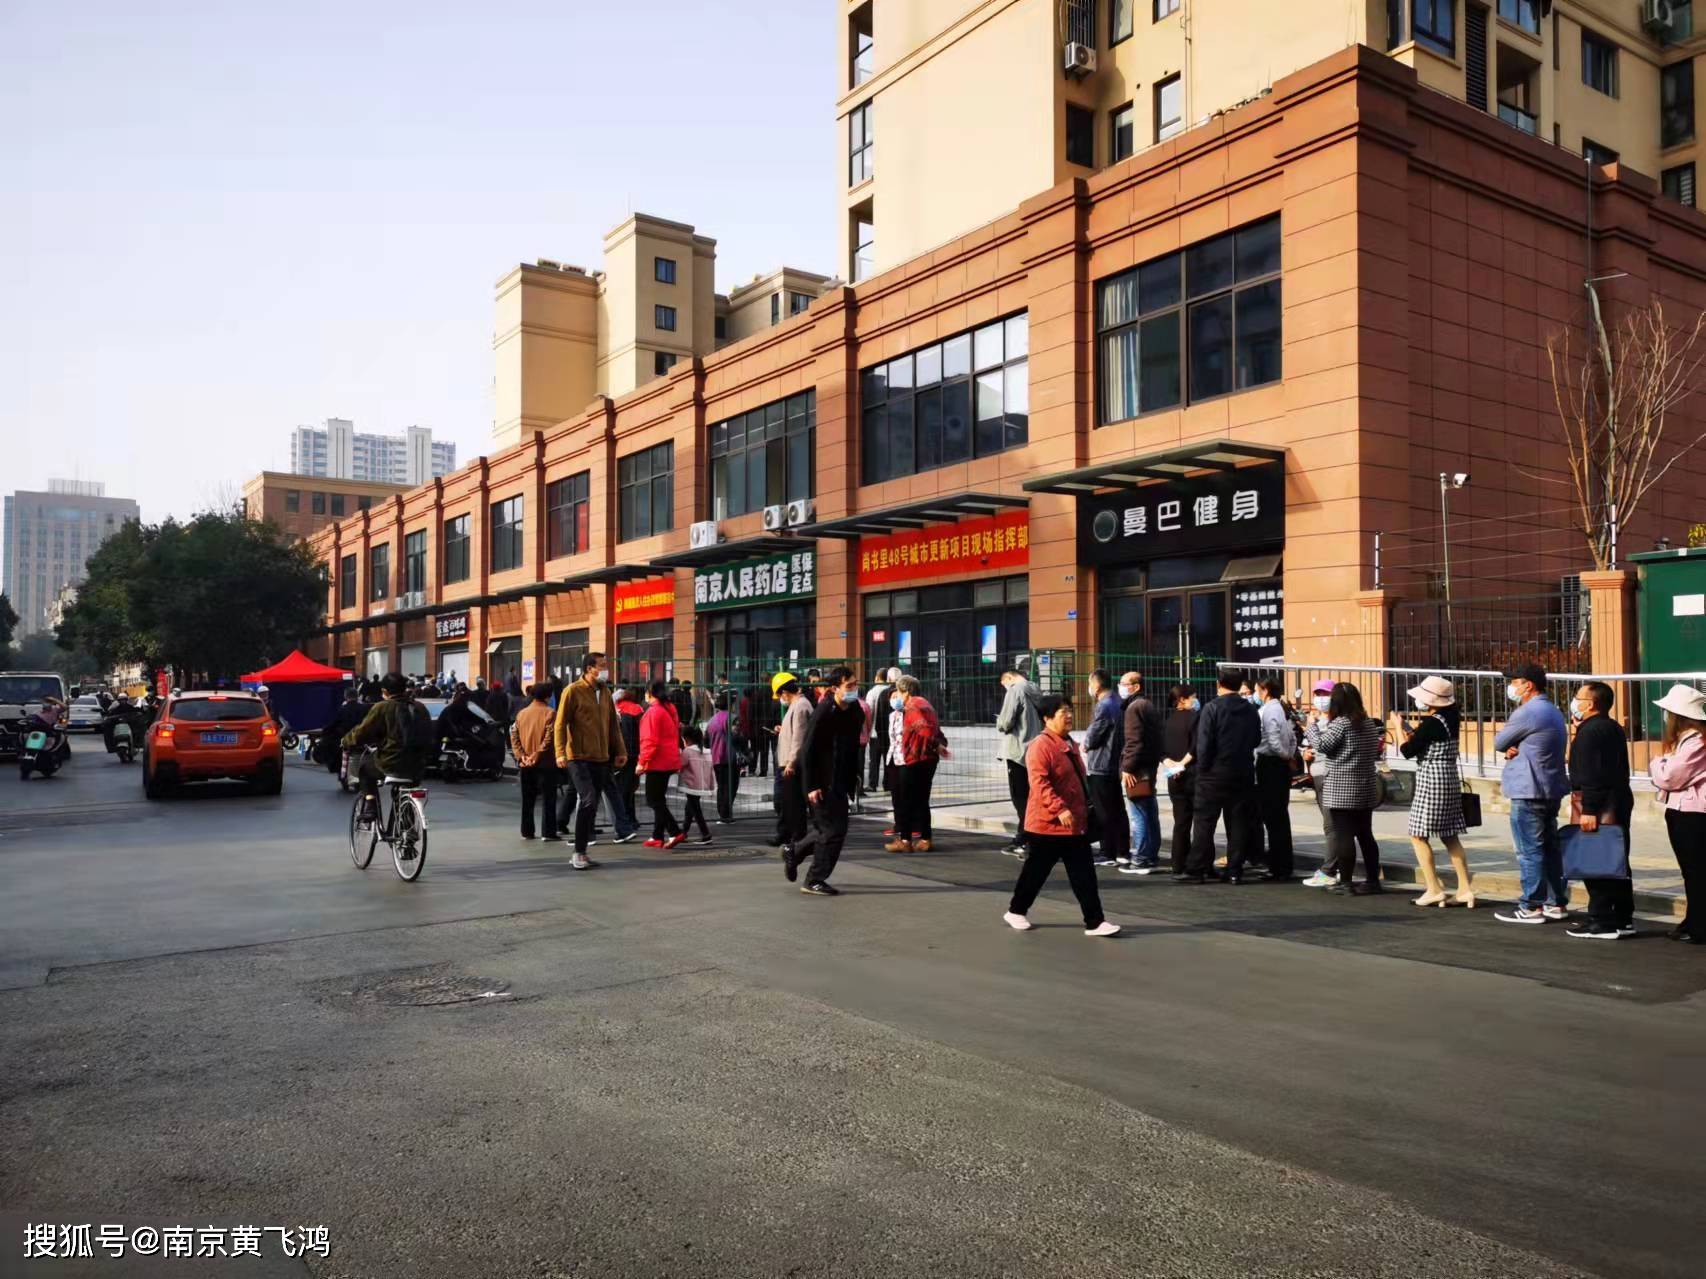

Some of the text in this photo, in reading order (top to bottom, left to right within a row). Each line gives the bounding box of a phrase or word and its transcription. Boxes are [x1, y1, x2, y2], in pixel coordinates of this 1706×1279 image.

[1123, 490, 1260, 537] 曼巴健身
[791, 552, 813, 573] 医保
[862, 525, 1028, 572] 尚书里48号城市更新项目现场指挥部
[694, 561, 788, 604] 南京人民药店
[791, 573, 813, 594] 定点
